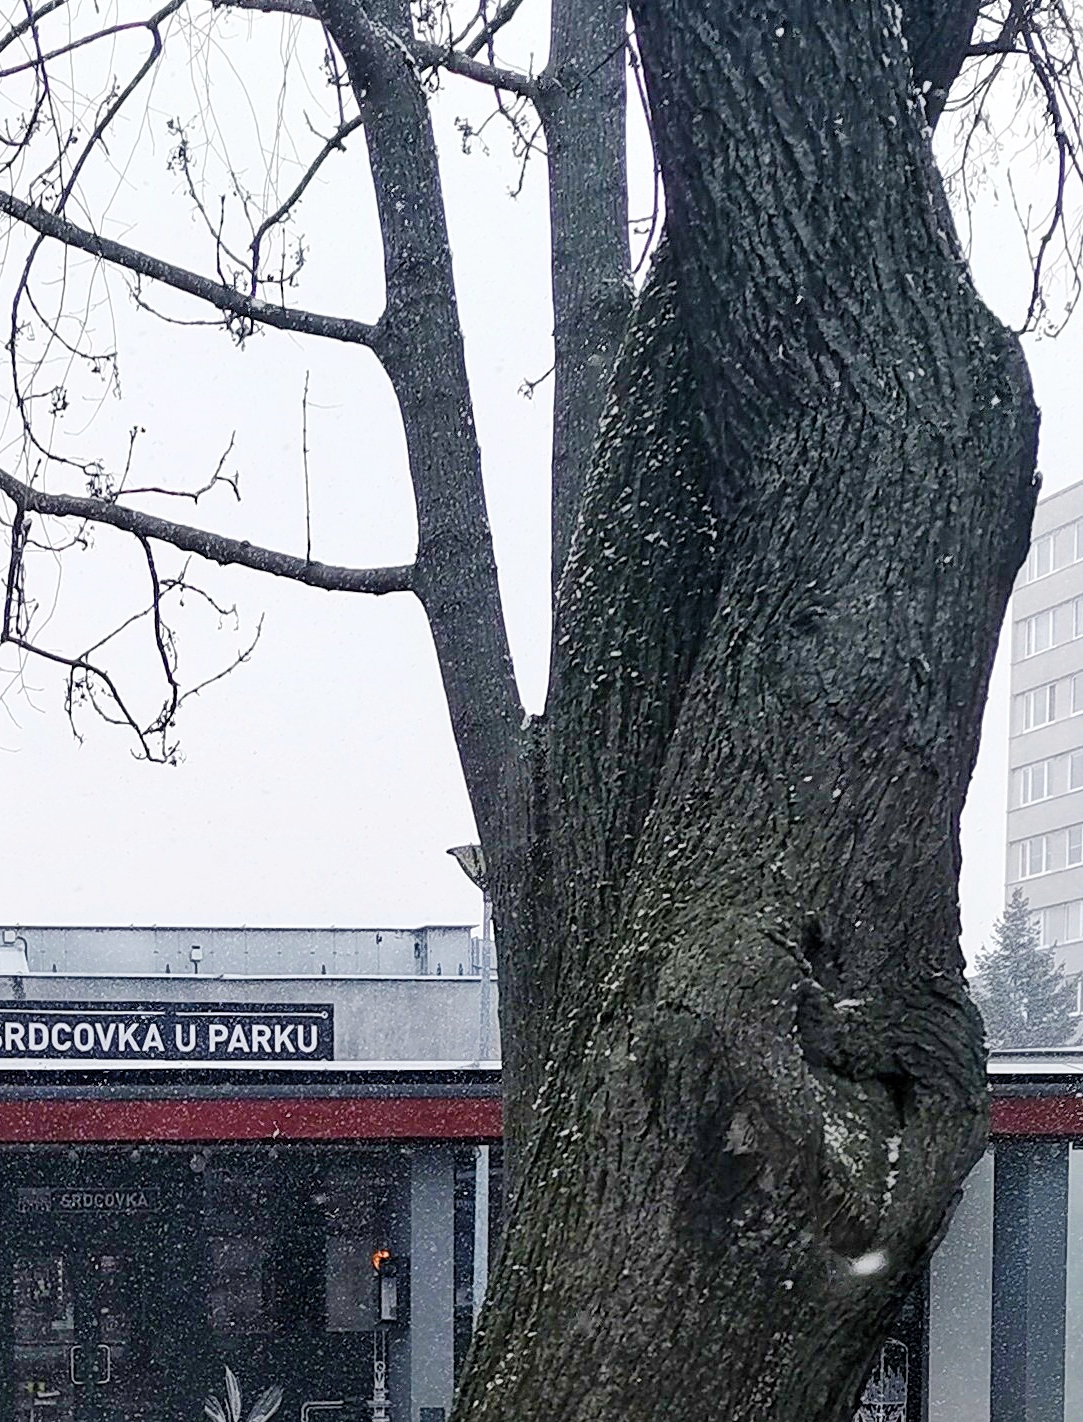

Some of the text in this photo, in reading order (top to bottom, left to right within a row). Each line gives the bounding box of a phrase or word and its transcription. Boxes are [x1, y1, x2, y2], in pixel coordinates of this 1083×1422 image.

[175, 1024, 197, 1052] U
[208, 1024, 319, 1053] PARKU
[60, 1191, 148, 1209] SRDCOVKA
